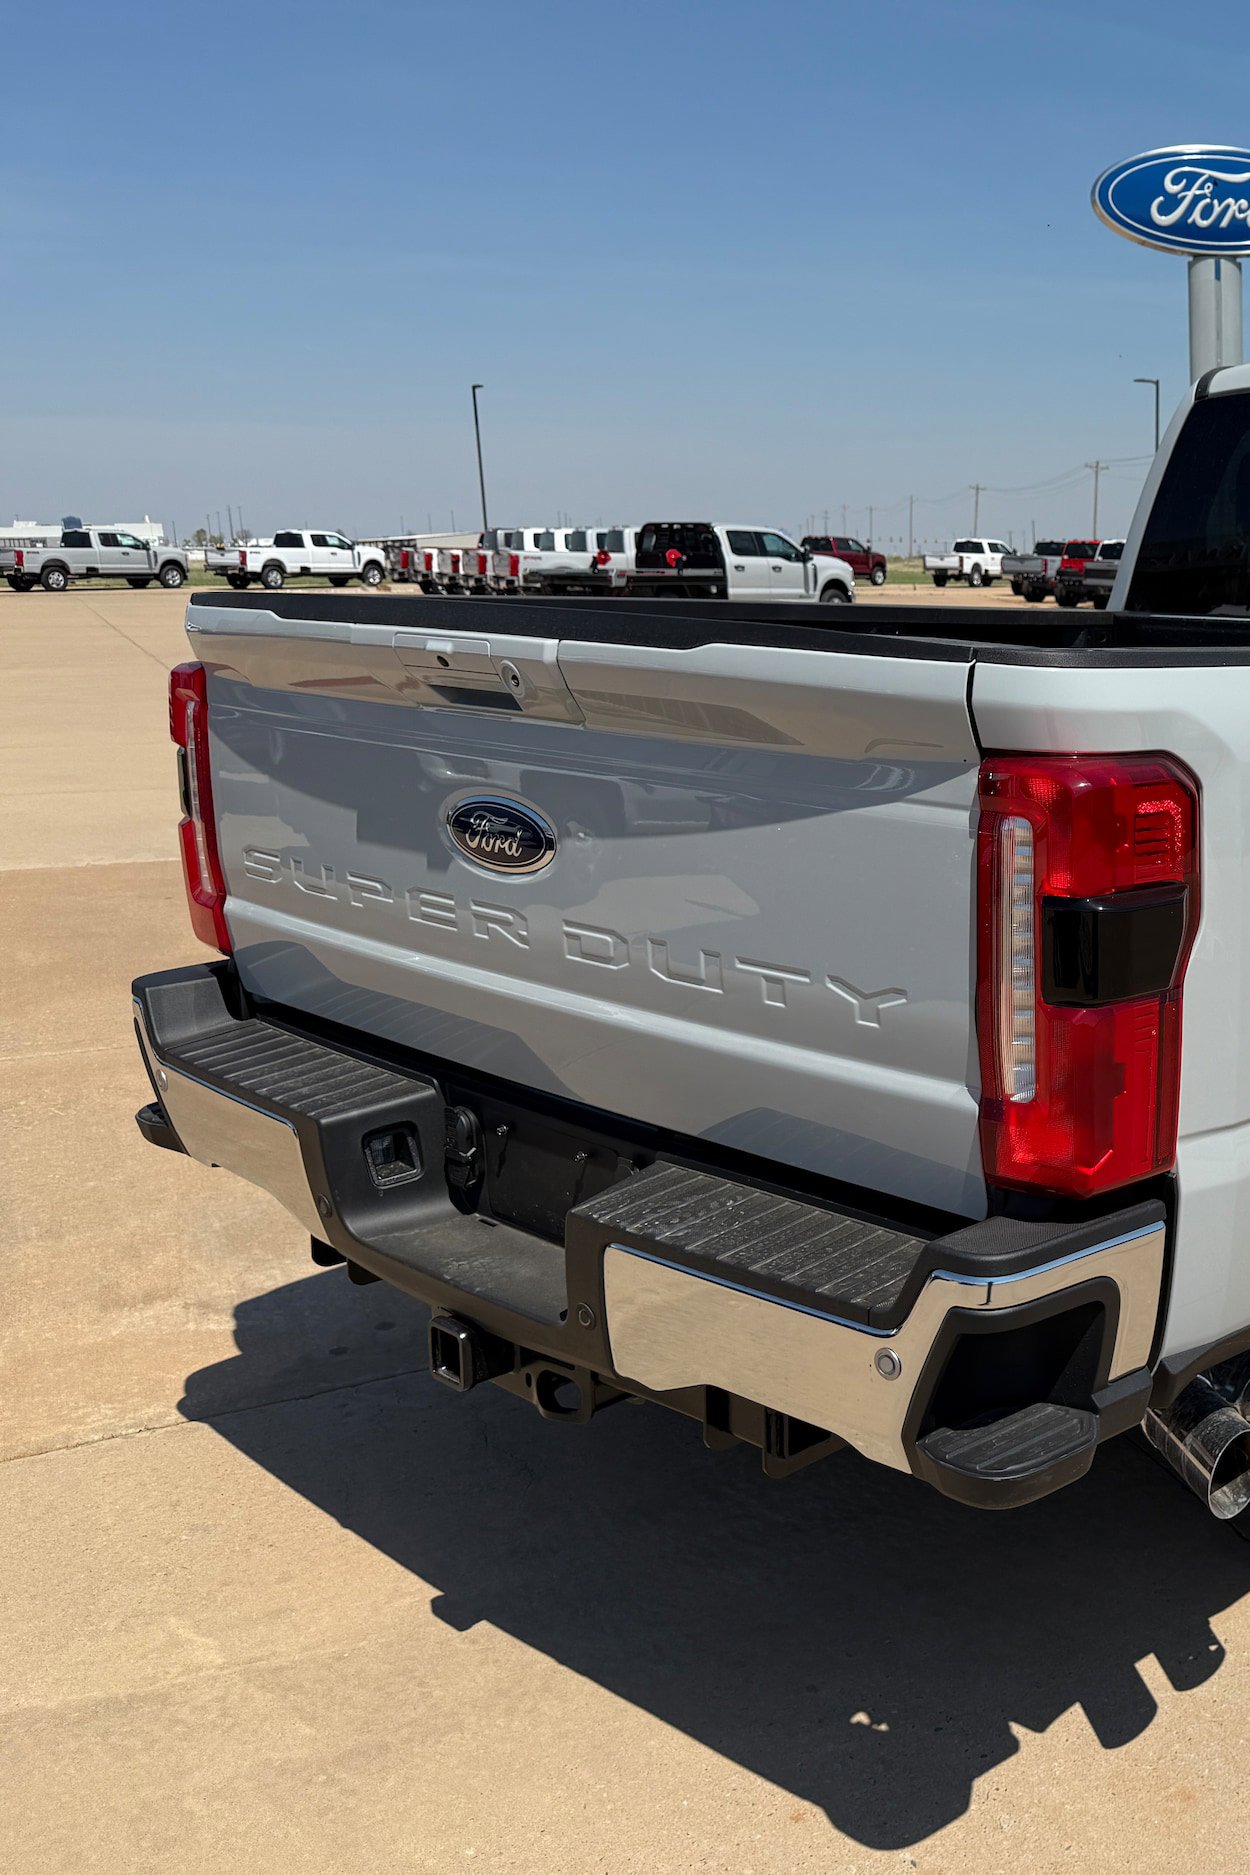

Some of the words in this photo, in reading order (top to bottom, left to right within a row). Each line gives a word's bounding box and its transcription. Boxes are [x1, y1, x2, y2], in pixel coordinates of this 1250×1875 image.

[465, 810, 523, 857] Ford
[243, 847, 529, 949] SUPER
[563, 919, 907, 1028] DUTY
